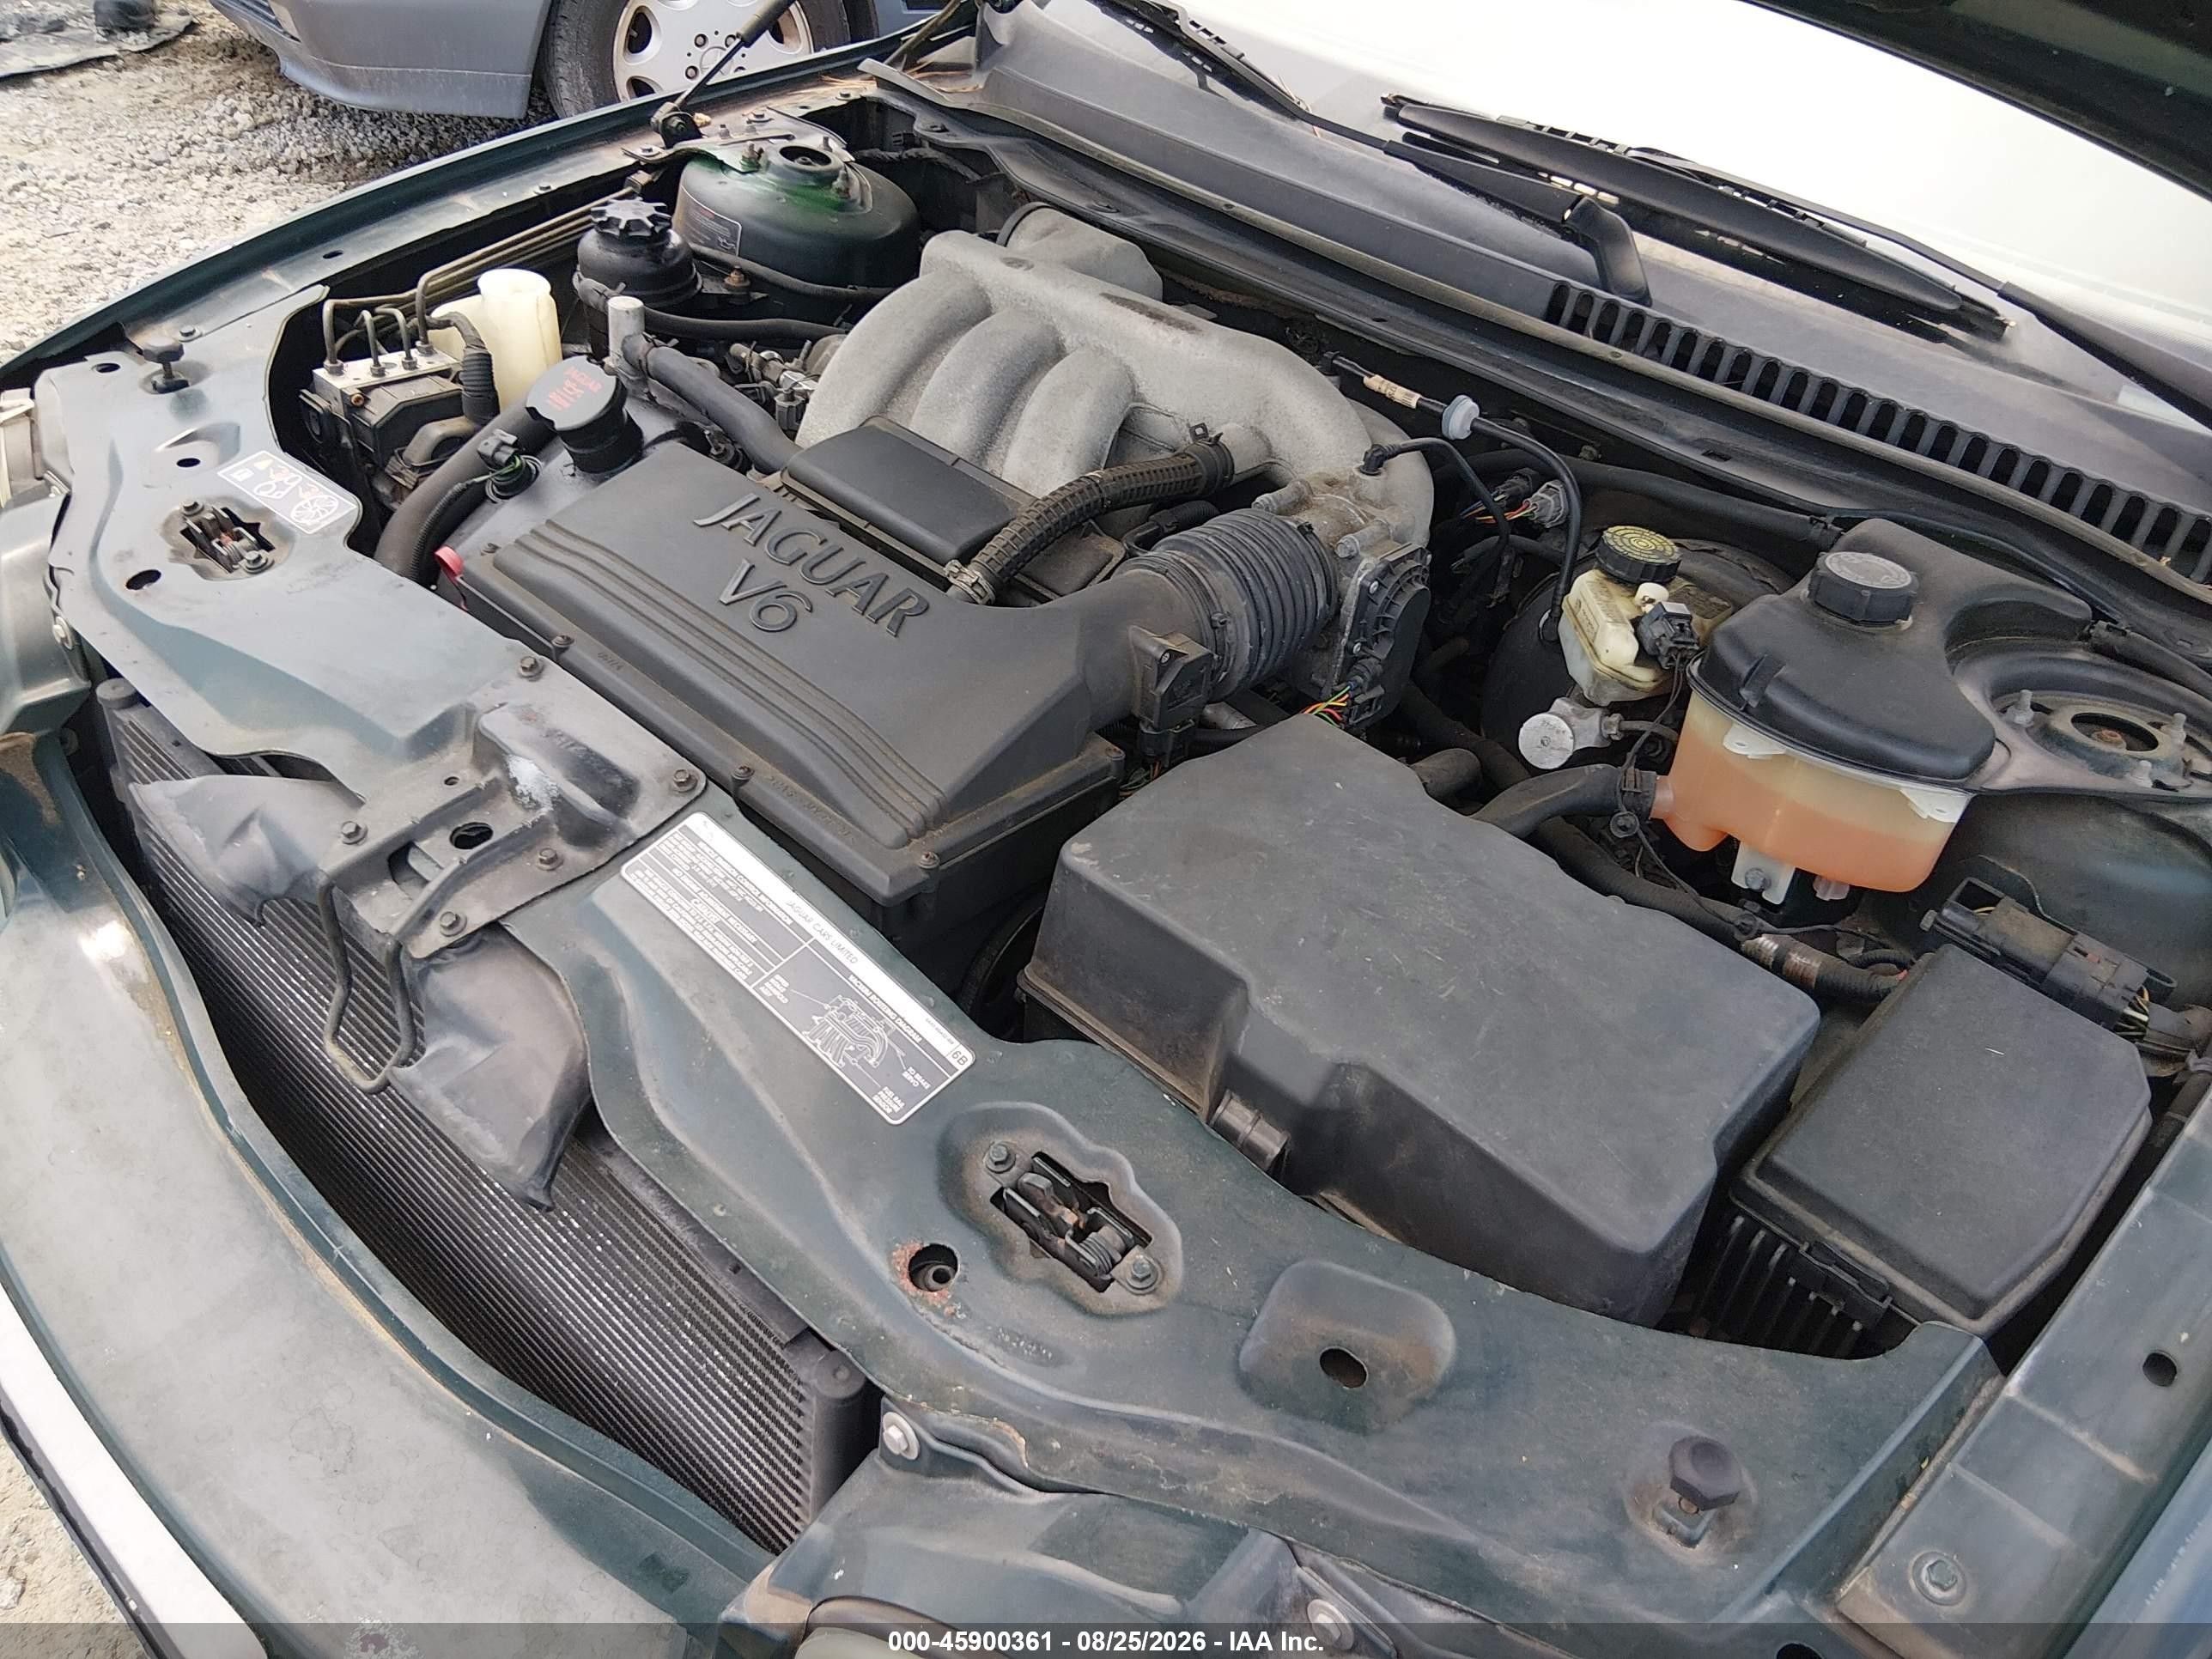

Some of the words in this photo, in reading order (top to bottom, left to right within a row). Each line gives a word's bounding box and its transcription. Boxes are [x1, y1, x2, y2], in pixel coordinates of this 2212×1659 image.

[694, 493, 930, 637] JAGUAR
[720, 558, 813, 633] V6
[690, 896, 721, 925] CATALYST
[785, 899, 814, 924] JAGUAR
[810, 921, 833, 941] CARS
[829, 939, 860, 964] LIMITED
[949, 1048, 969, 1066] 6B
